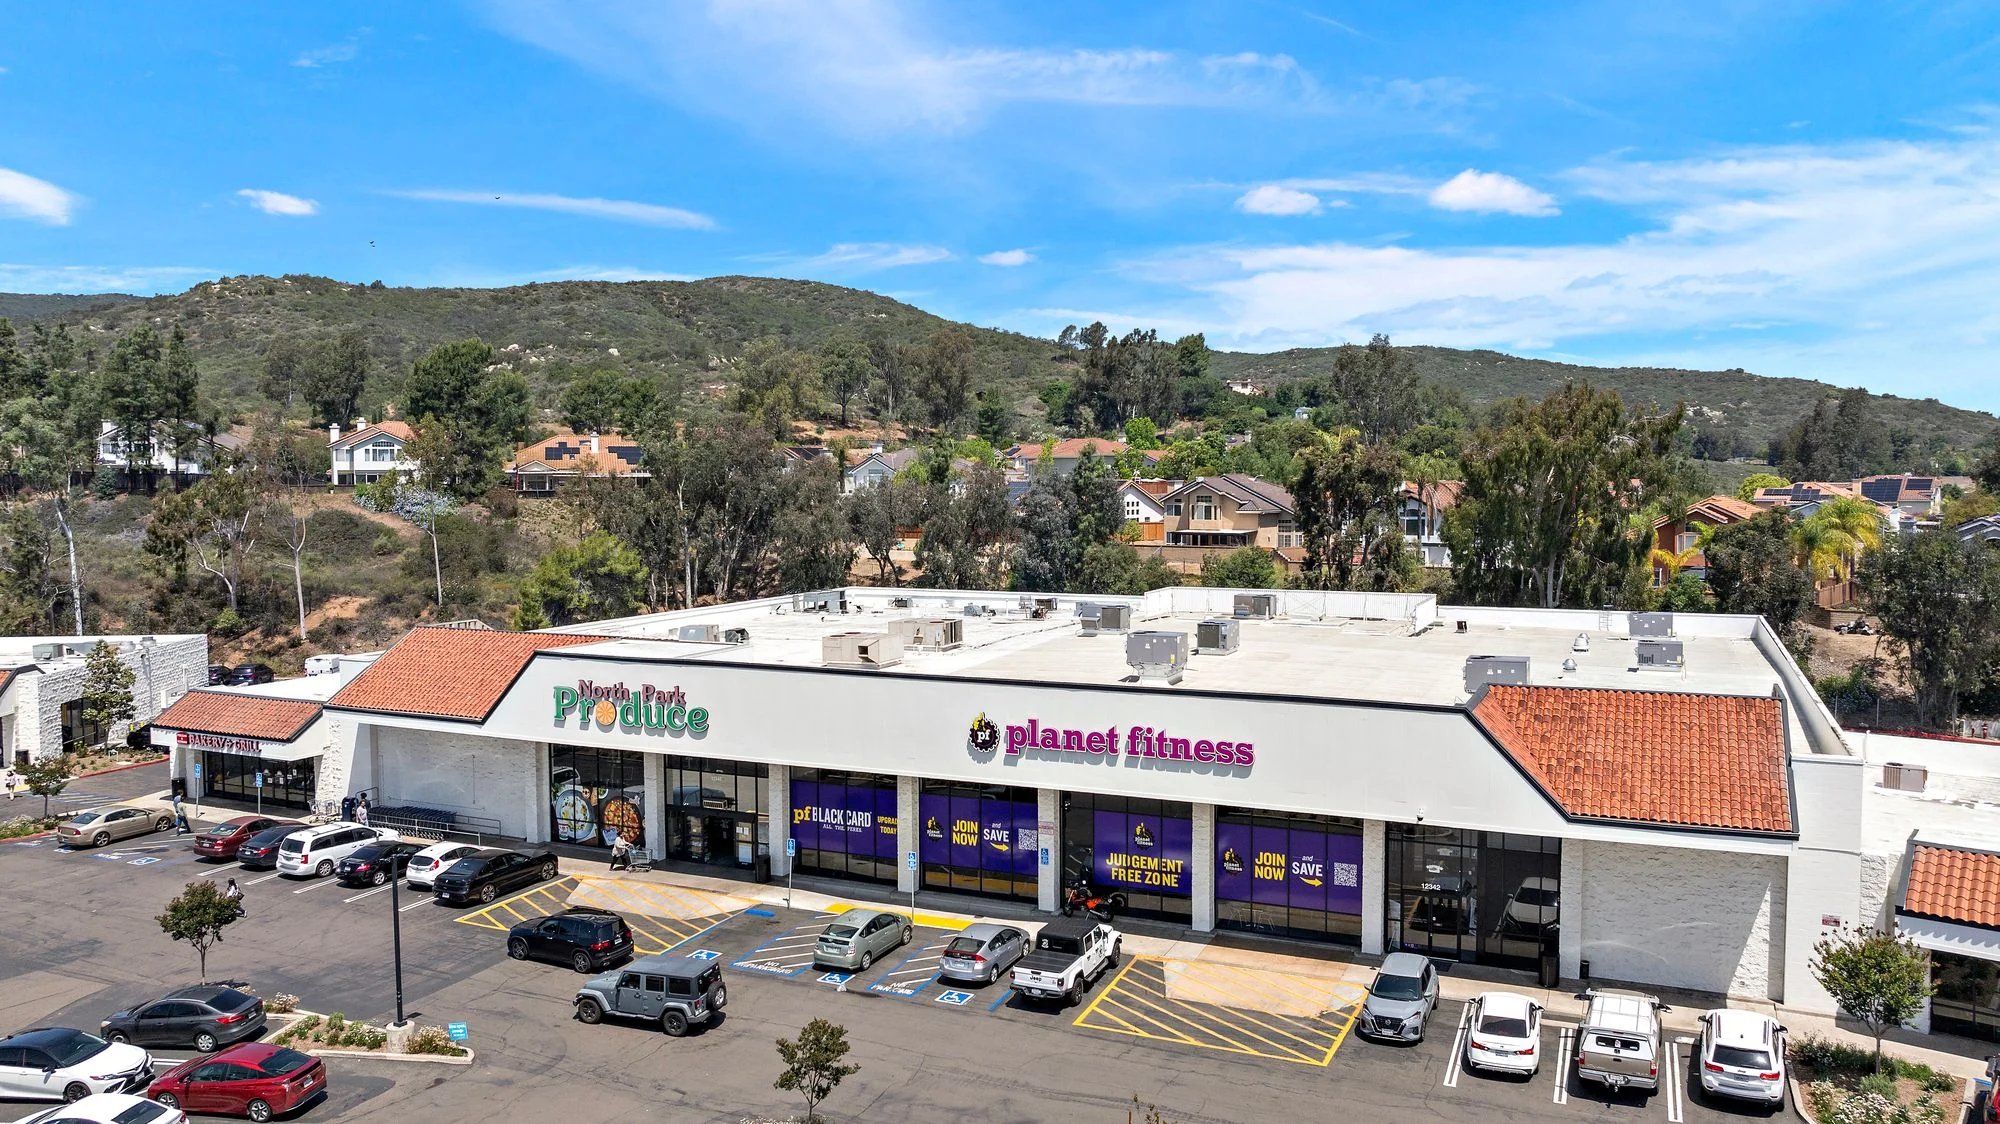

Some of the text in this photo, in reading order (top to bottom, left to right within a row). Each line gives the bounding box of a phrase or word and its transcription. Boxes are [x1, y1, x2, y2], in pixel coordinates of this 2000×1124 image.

[577, 679, 687, 704] North Park
[188, 734, 225, 748] BAKERY
[233, 740, 261, 752] GRILL
[976, 730, 991, 742] pf
[1005, 718, 1255, 766] planet fitness
[793, 806, 811, 824] pf
[812, 806, 844, 825] BLACK
[953, 819, 978, 834] JOIN
[952, 832, 978, 846] NOW
[983, 828, 1010, 843] SAVE
[1106, 852, 1184, 873] JUDGEMENT
[1255, 851, 1286, 867] JOIN
[1111, 867, 1179, 887] FREE ZONE
[1254, 865, 1286, 881] NOW
[1291, 861, 1323, 877] SAVE
[1421, 883, 1441, 891] 12342
